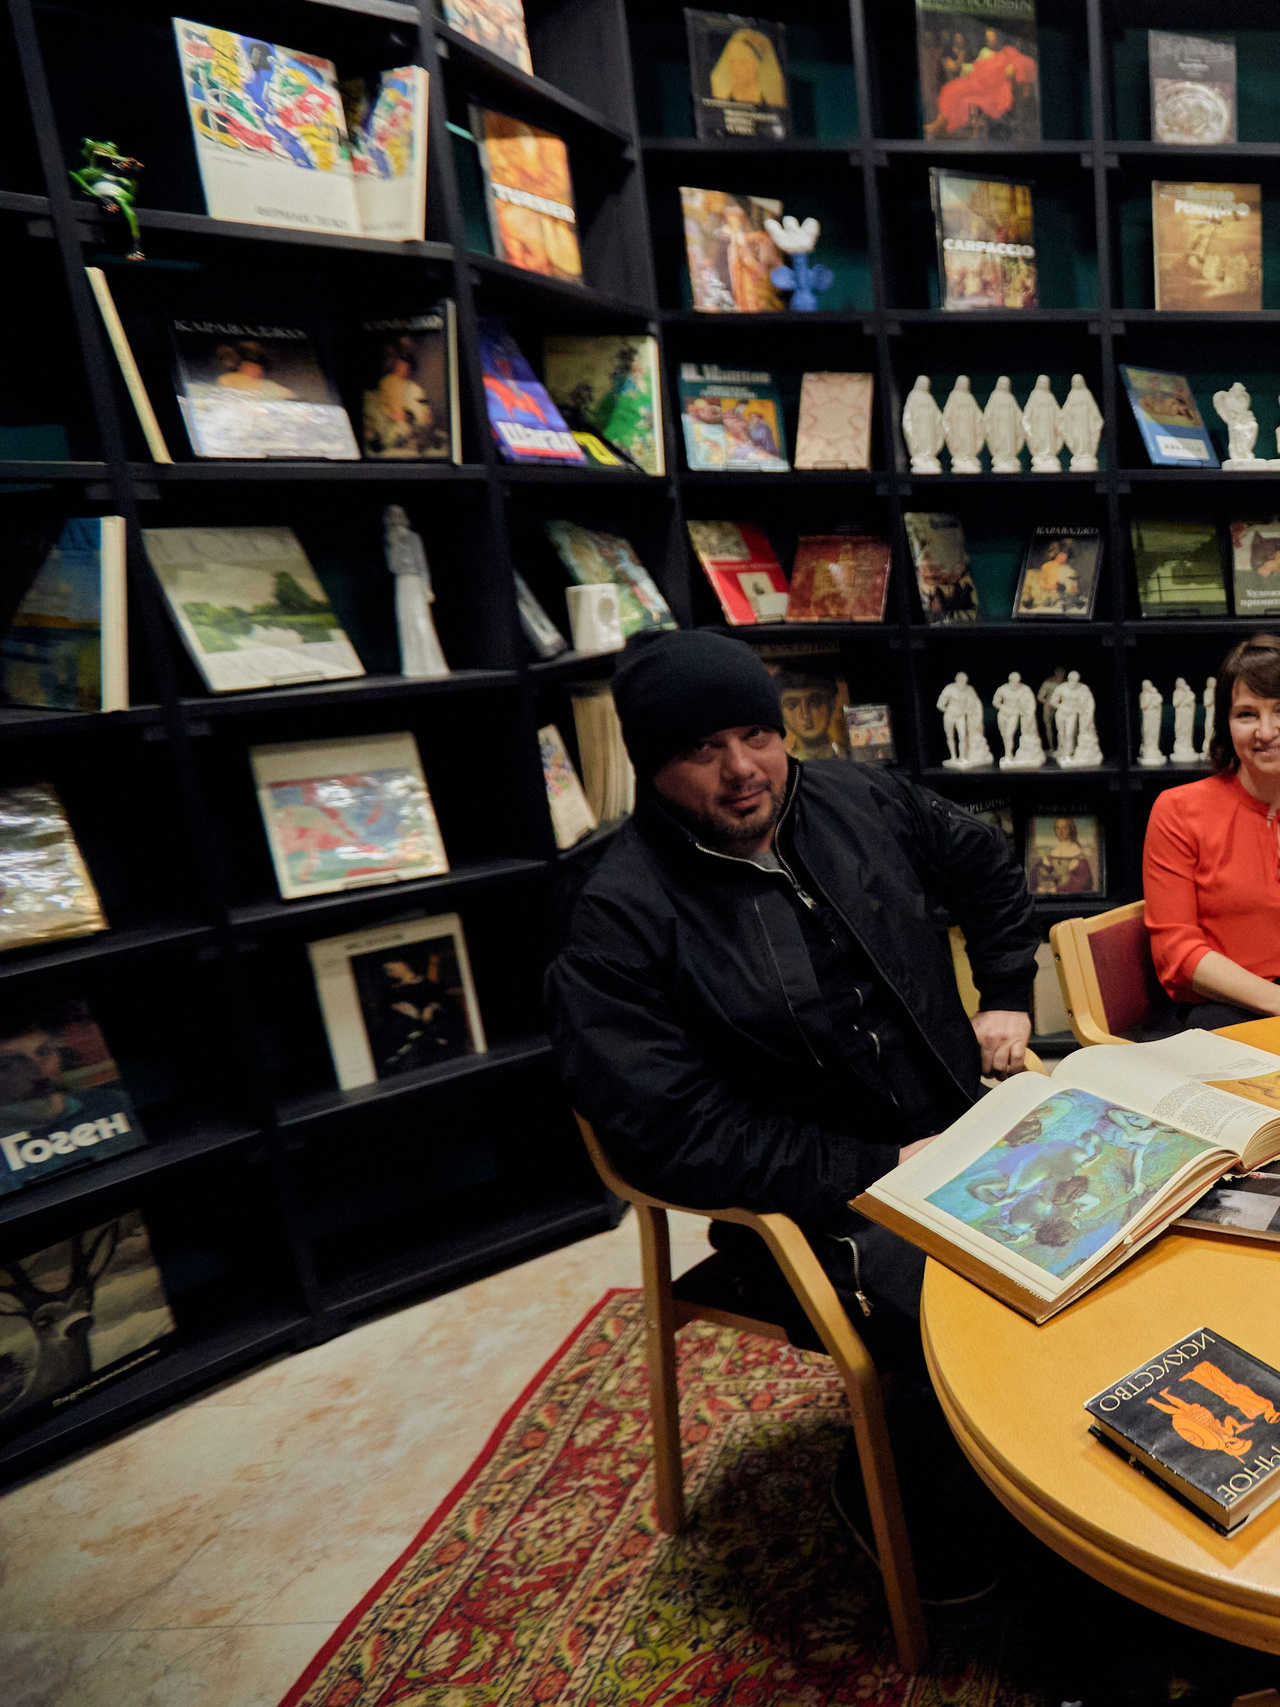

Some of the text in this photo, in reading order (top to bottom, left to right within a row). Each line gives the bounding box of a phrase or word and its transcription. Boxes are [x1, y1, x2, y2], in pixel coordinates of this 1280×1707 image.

[943, 238, 1035, 259] CARPACCIO
[1035, 525, 1100, 536] КАРАВАДЖО
[1, 1112, 130, 1171] Гоген
[1099, 1332, 1216, 1413] ИСКУССТВО
